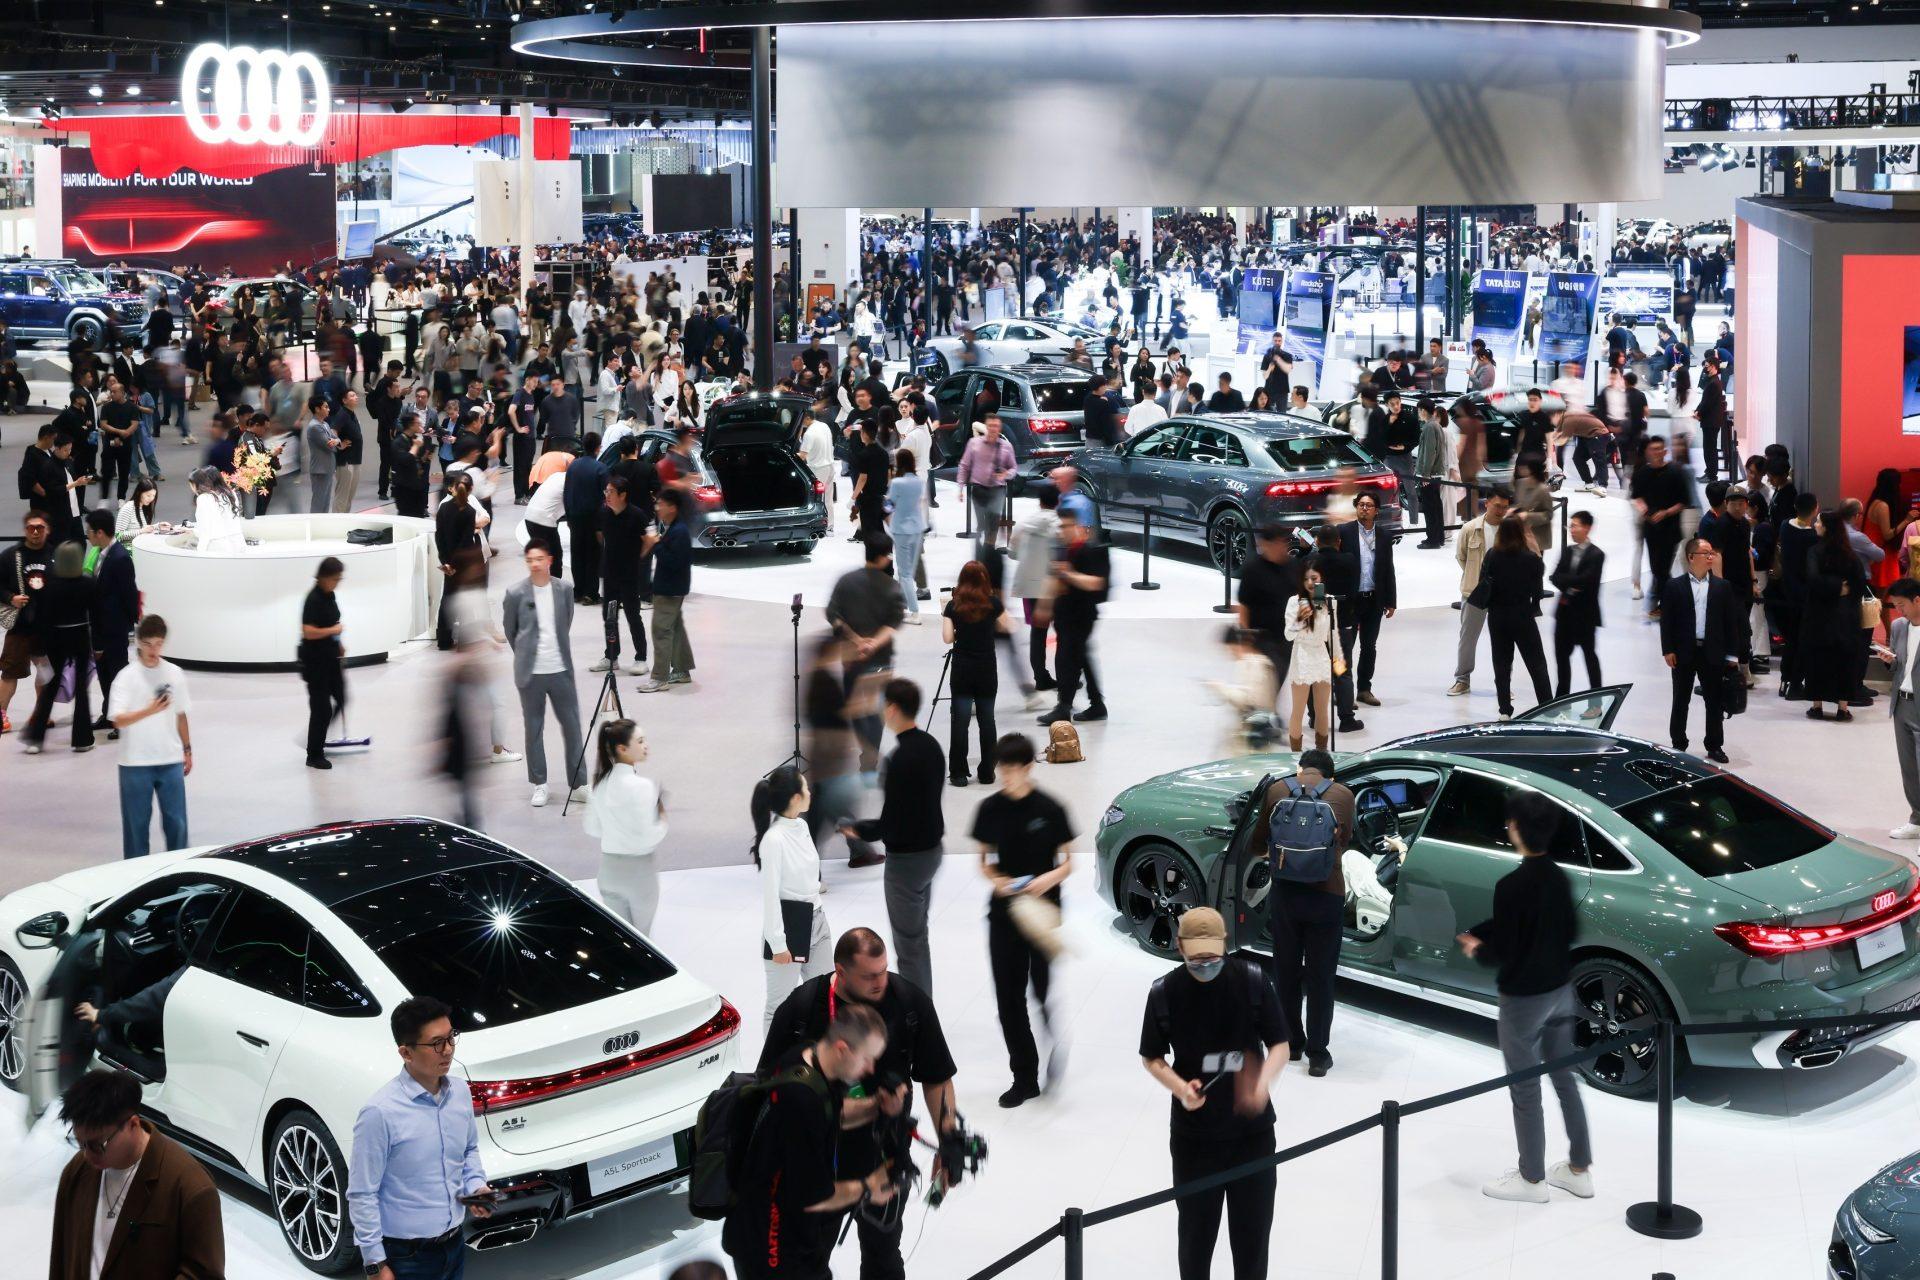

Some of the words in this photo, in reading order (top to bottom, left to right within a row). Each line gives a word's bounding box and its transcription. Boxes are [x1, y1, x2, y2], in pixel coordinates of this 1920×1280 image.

[63, 173, 87, 187] SHAPING
[134, 173, 158, 186] FOR
[1485, 278, 1503, 288] TATA
[604, 1166, 620, 1177] A5L
[621, 1152, 662, 1171] Sportback
